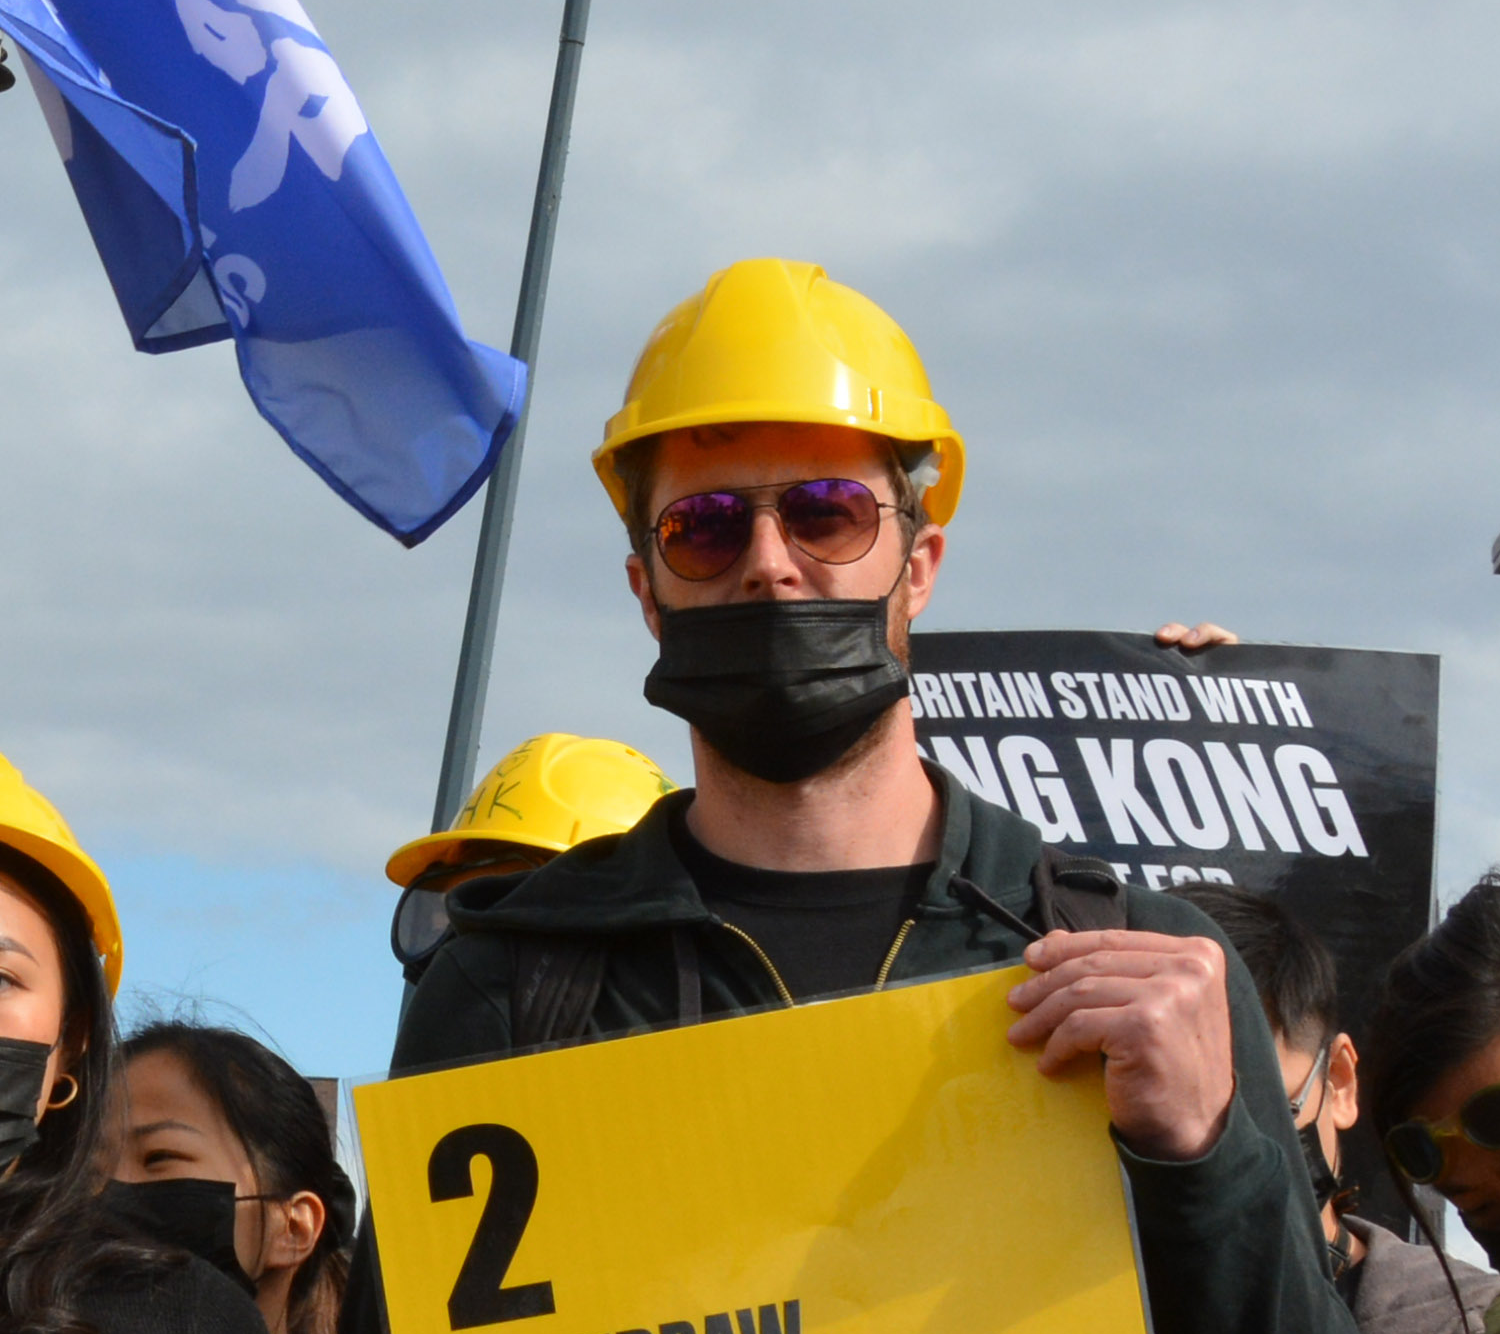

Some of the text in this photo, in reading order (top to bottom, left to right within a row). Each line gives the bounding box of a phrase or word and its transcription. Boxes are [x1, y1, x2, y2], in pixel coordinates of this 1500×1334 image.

[1059, 671, 1191, 722] STAND
[1188, 675, 1314, 729] WITH
[1075, 738, 1369, 857] KONG
[428, 1123, 555, 1332] 2
